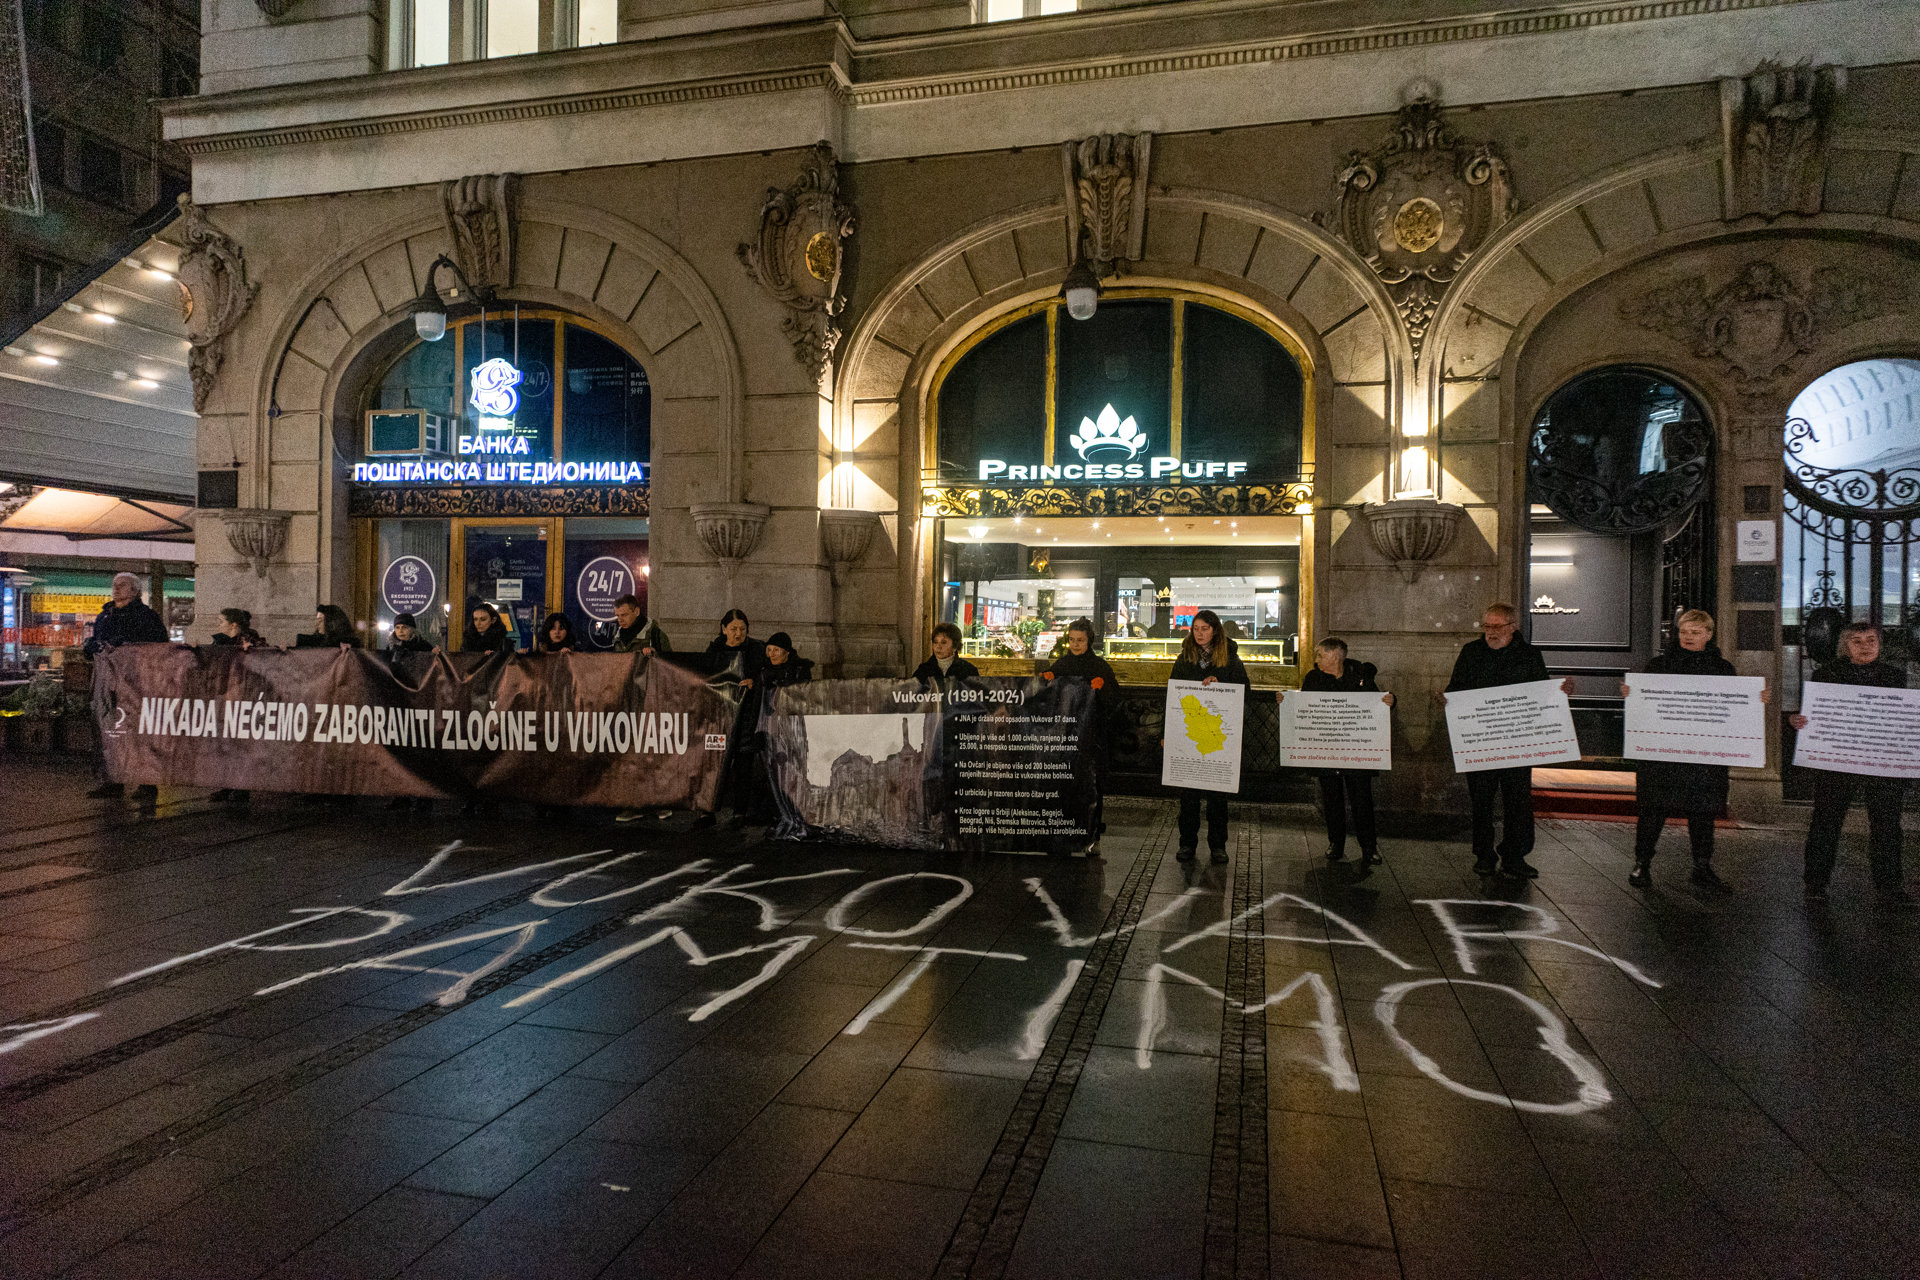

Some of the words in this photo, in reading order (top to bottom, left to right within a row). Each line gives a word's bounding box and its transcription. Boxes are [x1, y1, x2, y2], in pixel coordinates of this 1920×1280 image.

[458, 435, 528, 455] БАНКА
[354, 461, 481, 483] ПОШТАНСКА
[486, 461, 643, 485] ШТЕДИОНИЦА
[979, 459, 1144, 480] PRINCESS
[1151, 456, 1247, 479] PUFF
[588, 570, 624, 596] 24/7
[892, 690, 944, 703] Vukovar
[947, 690, 1024, 705] (1991-2024)
[138, 697, 217, 738] NIKADA
[223, 692, 308, 742] NEĆEMO
[313, 703, 435, 749] ZABORAVITI
[441, 701, 537, 751] ZLOČINE
[545, 711, 560, 752] U
[567, 711, 689, 755] VUKOVARU
[995, 715, 1005, 723] pod
[959, 733, 980, 741] Ubijeno
[1023, 734, 1039, 742] civila,
[1040, 735, 1060, 743] ranjeno
[984, 743, 1007, 751] nesrpsko
[992, 761, 1011, 770] ubijeno
[959, 770, 982, 778] ranjenih
[982, 771, 1013, 779] zarobljenika
[1045, 791, 1059, 799] grad.
[973, 807, 990, 816] logore
[959, 816, 984, 825] Beograd,
[1020, 818, 1047, 826] Mitrovica,
[1048, 819, 1075, 827] Stajićevo)
[959, 826, 977, 834] prošlo
[1016, 827, 1049, 836] zarobljenika
